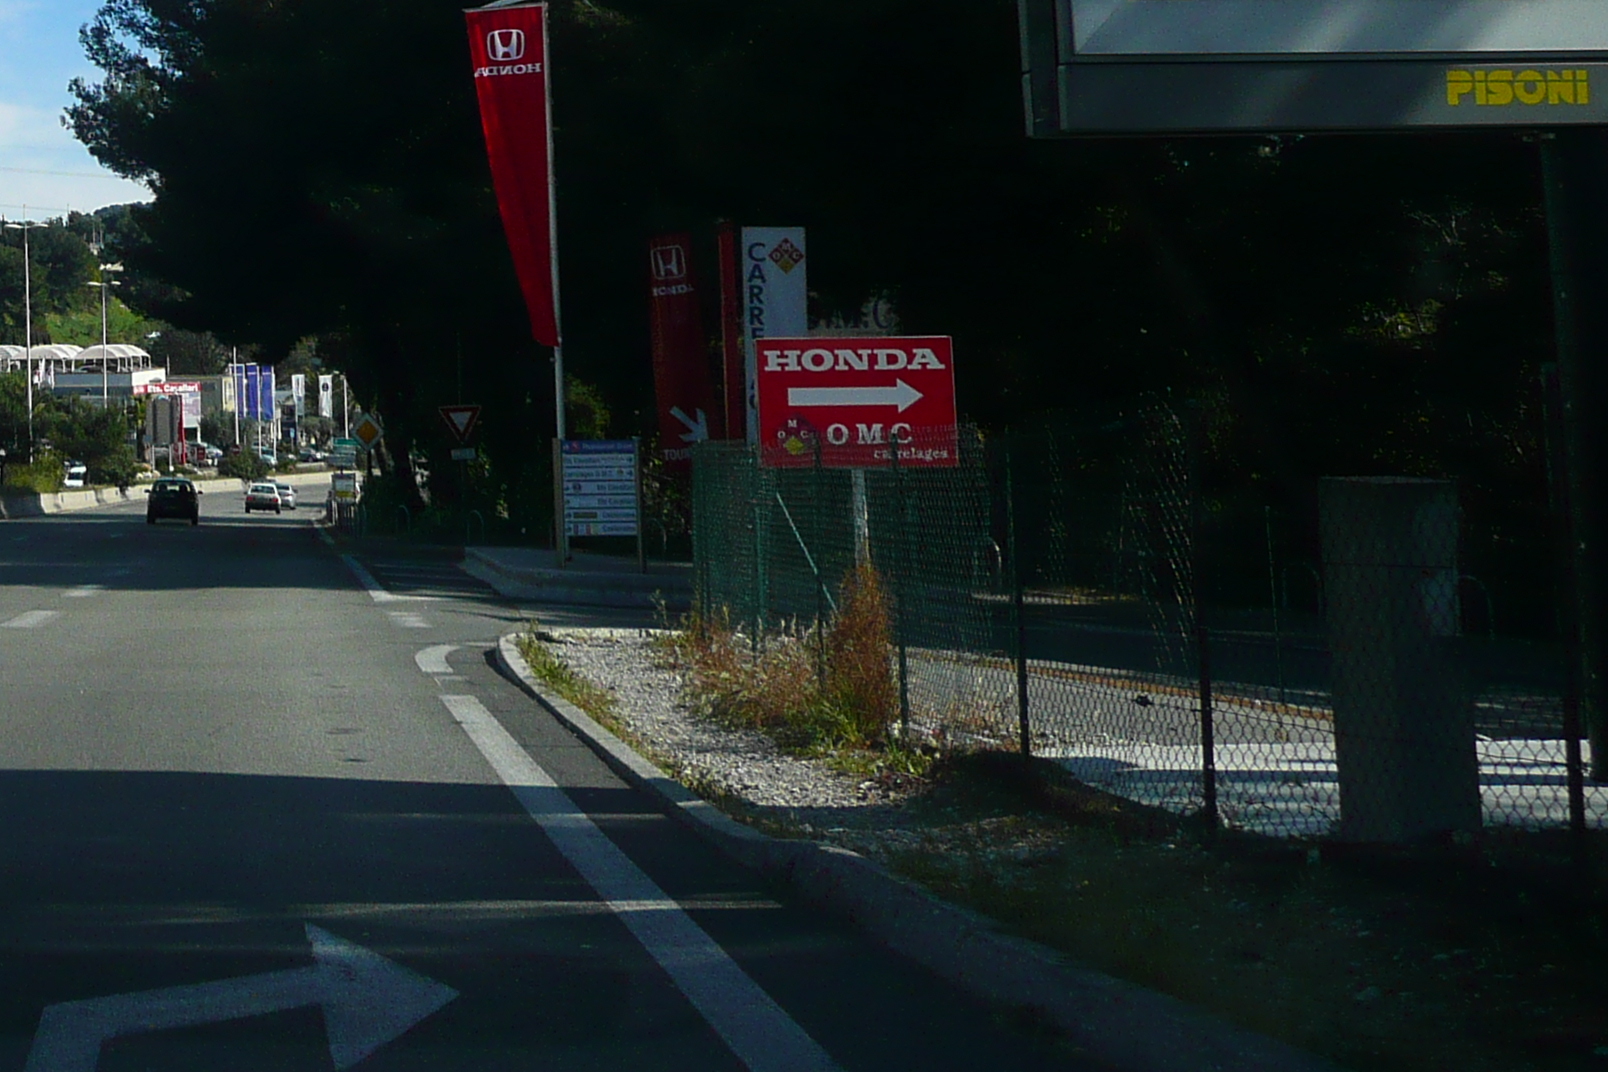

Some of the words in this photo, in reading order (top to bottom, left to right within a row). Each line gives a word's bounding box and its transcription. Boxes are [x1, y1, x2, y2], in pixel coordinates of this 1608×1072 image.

[1446, 69, 1589, 106] PISONI
[763, 348, 946, 372] HONDA
[873, 447, 949, 462] carelages
